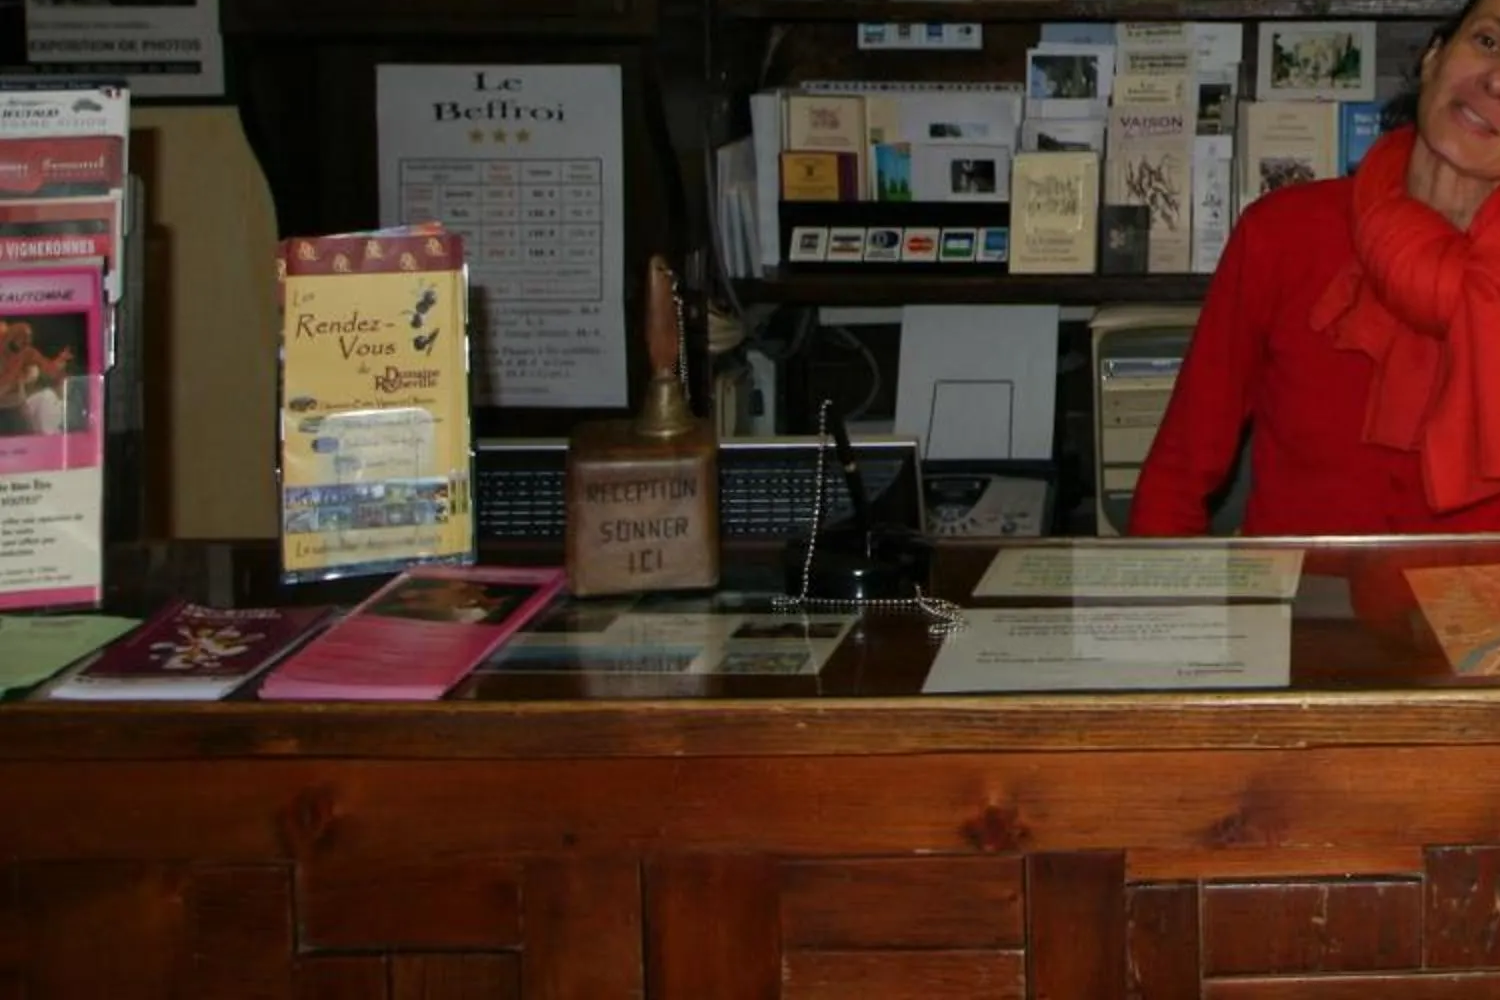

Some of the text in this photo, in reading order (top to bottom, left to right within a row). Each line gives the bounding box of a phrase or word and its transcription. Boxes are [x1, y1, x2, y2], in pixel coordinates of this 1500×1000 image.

[472, 71, 524, 93] Le
[431, 100, 567, 123] Beffroi
[339, 334, 397, 361] Vous
[585, 478, 697, 504] RECEPTION
[627, 548, 664, 574] ICI
